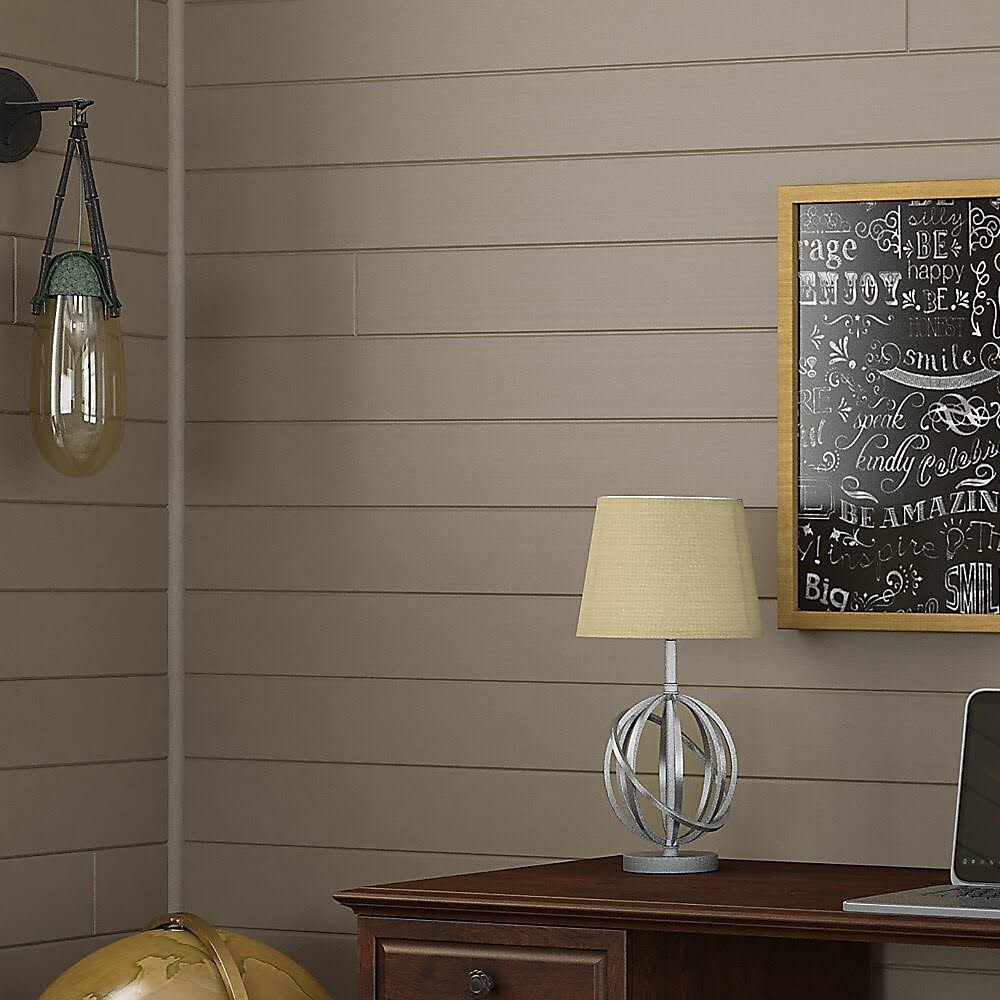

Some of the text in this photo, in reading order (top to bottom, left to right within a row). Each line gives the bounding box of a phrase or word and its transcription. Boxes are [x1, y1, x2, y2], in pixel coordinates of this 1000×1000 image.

[908, 206, 966, 237] silly
[916, 229, 949, 259] BE
[907, 260, 965, 284] happy
[799, 270, 902, 305] ENJOY
[922, 287, 948, 313] BE
[909, 317, 965, 337] HONEST
[903, 344, 976, 372] smile
[856, 434, 930, 494] kindly
[838, 499, 875, 528] BE
[828, 536, 940, 582] inspire
[805, 572, 849, 612] Big
